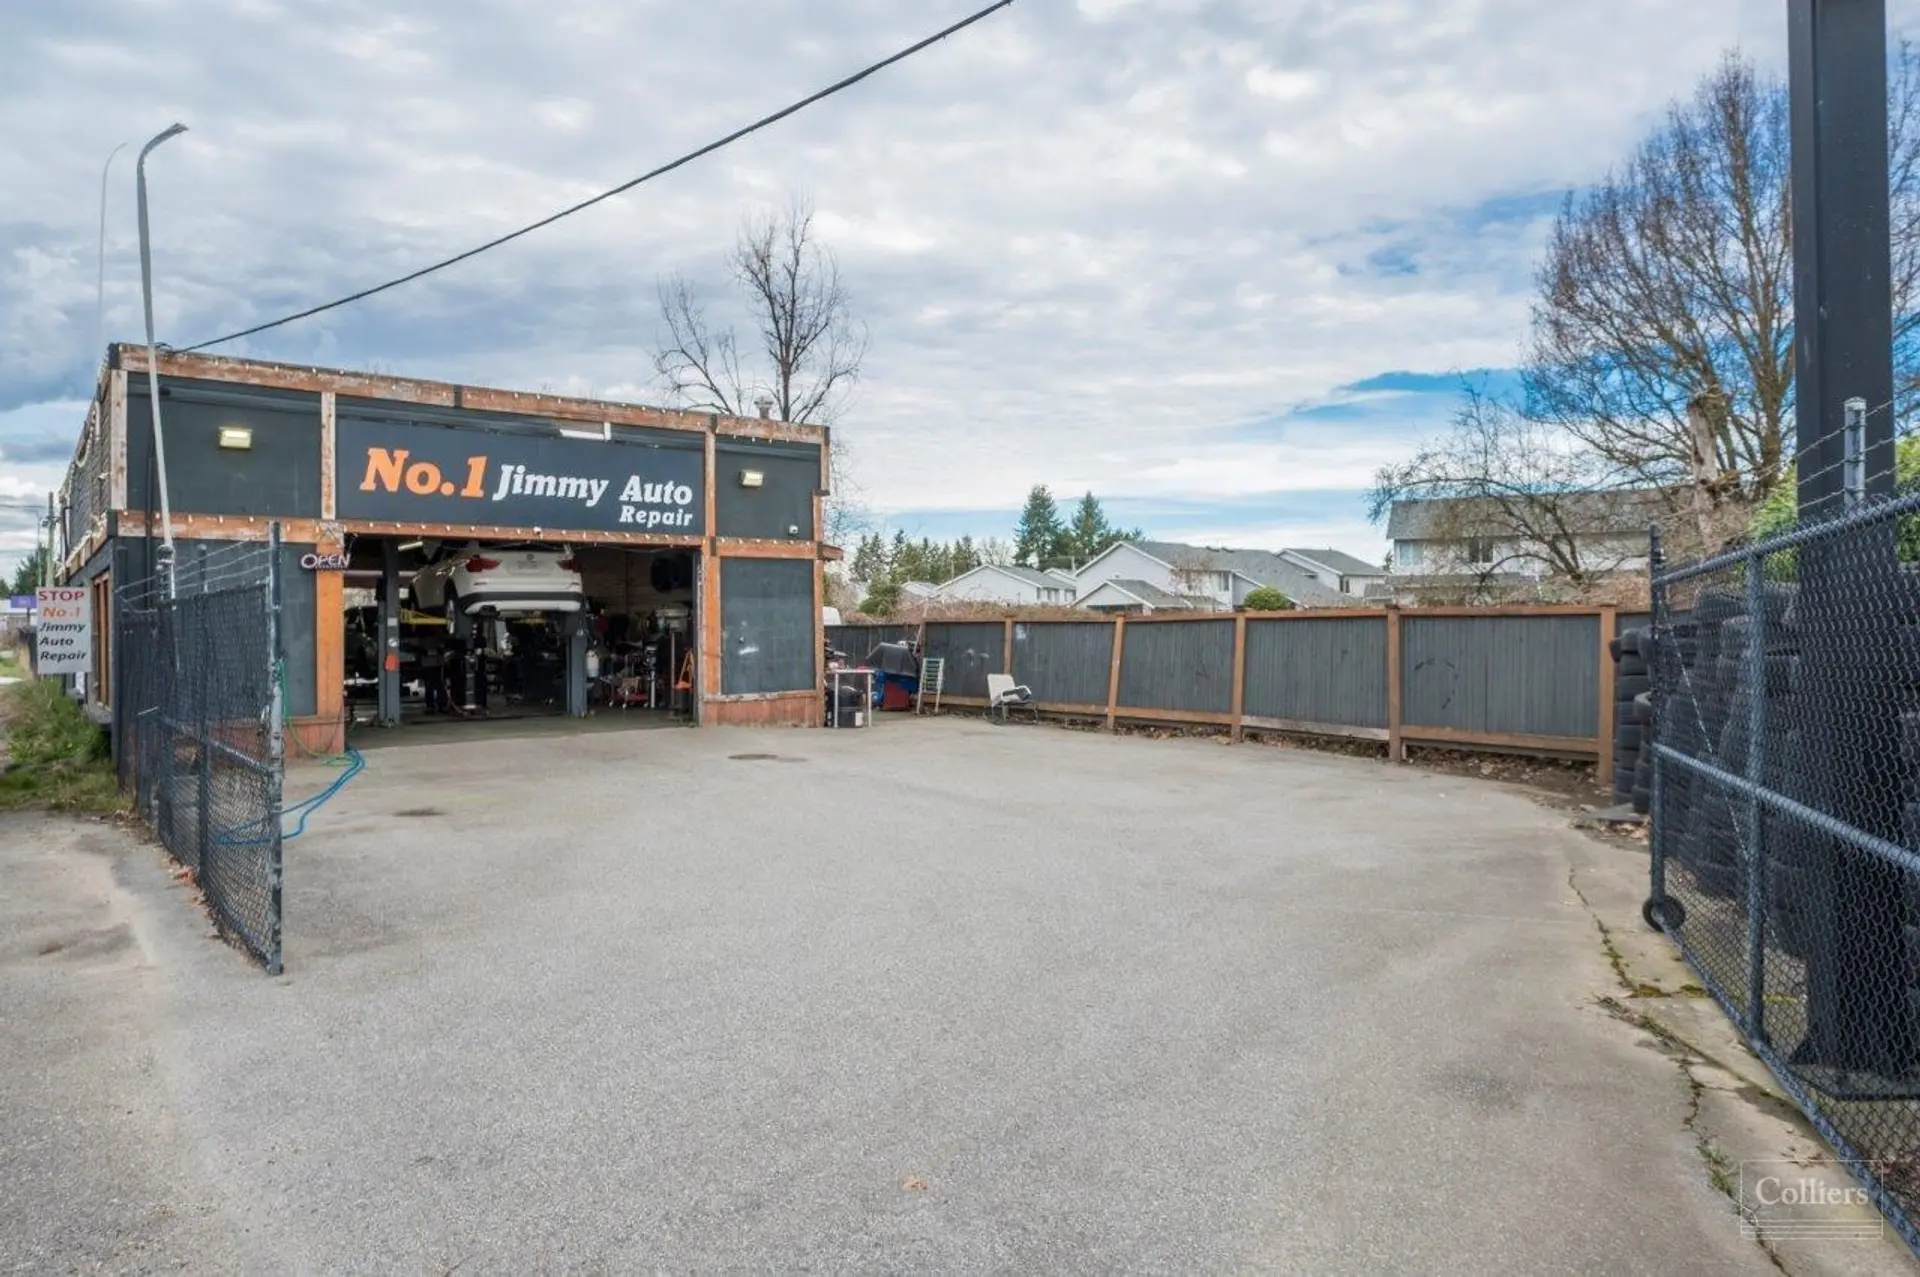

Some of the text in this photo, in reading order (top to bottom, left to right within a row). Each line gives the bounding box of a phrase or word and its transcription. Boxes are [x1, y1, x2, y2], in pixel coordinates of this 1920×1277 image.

[360, 447, 692, 506] No.1 Jimmy Auto
[619, 506, 692, 527] Repair
[301, 553, 350, 568] OPEN
[39, 590, 84, 601] STOP
[39, 622, 86, 633] Jimmy
[39, 637, 74, 646] Auto
[40, 650, 87, 662] Repair
